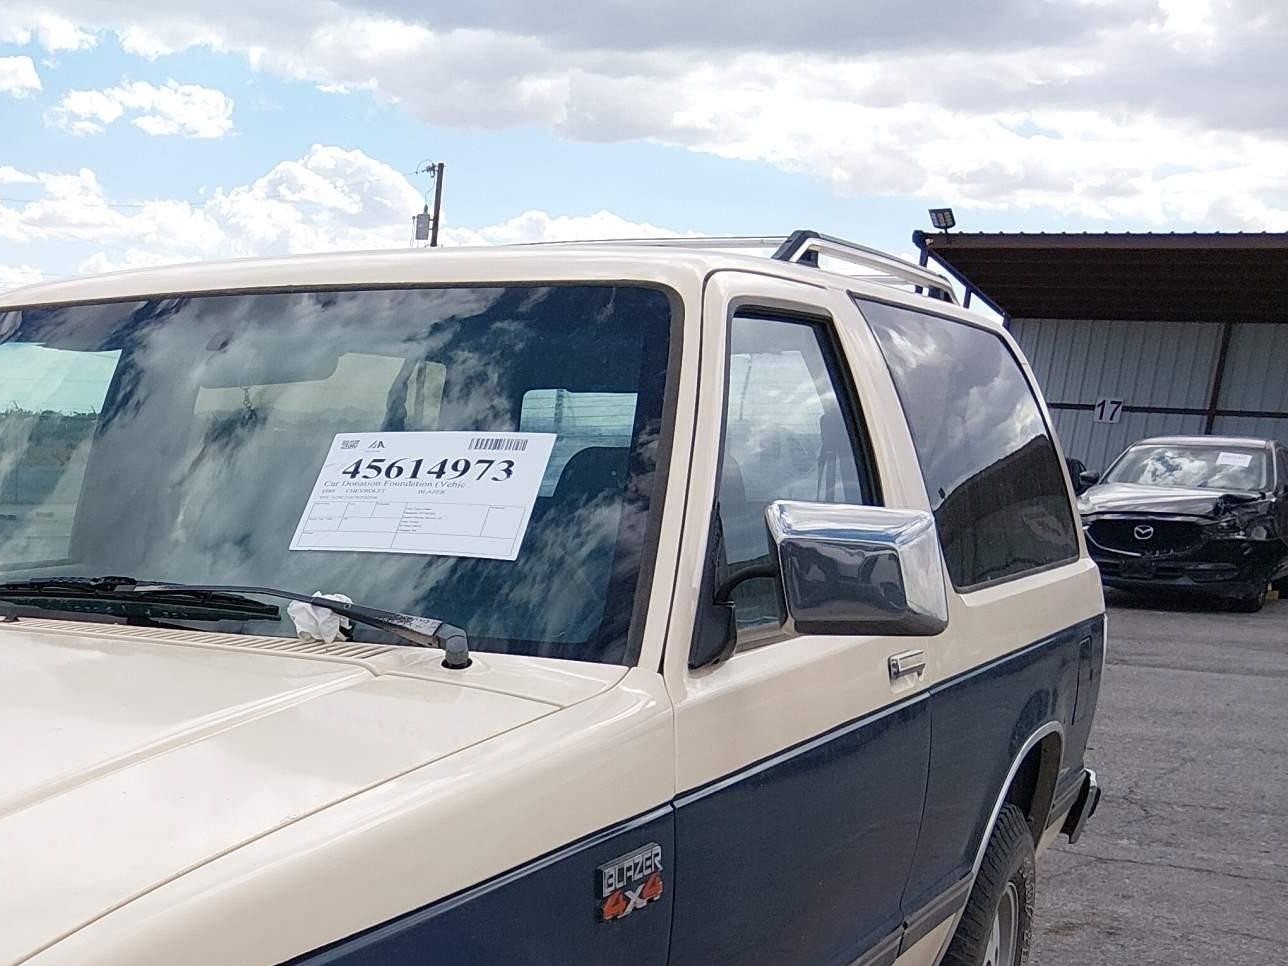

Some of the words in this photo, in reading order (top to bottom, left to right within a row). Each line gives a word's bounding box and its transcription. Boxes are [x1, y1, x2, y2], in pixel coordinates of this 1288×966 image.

[1097, 400, 1122, 421] 17
[342, 458, 515, 482] 45614973
[323, 480, 340, 488] Car
[383, 480, 433, 488] Foundation
[601, 844, 664, 899] BLAZER
